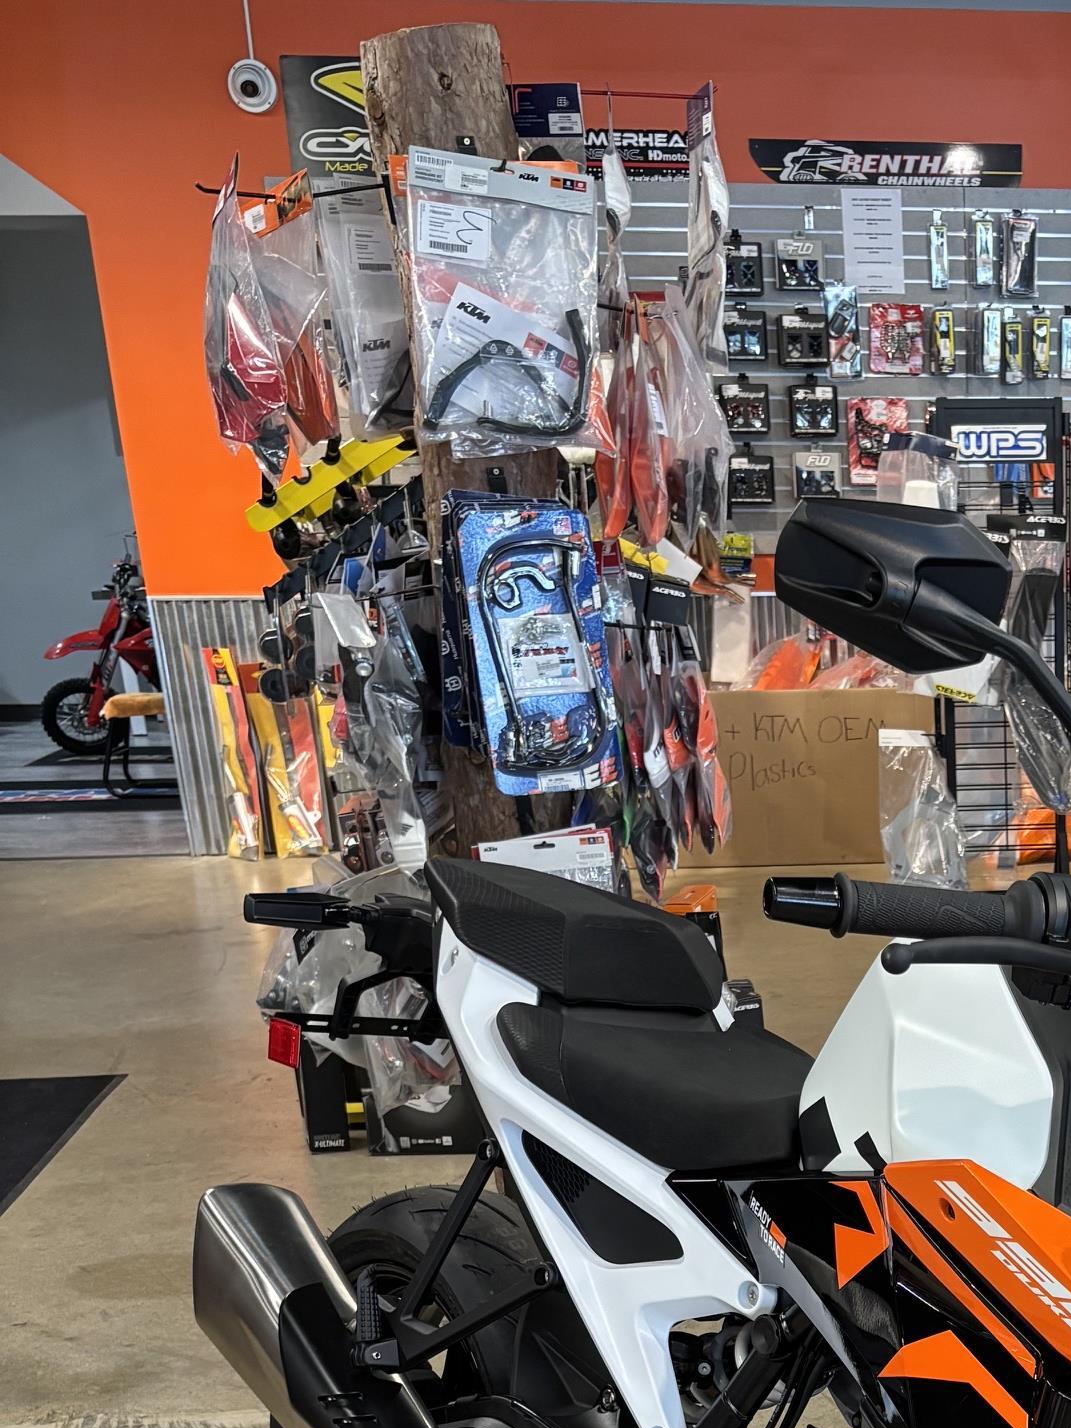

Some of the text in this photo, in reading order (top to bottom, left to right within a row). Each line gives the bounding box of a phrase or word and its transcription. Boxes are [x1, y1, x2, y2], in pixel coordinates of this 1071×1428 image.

[325, 161, 368, 172] Made
[840, 154, 982, 175] RENTHAL
[518, 172, 539, 183] KTM
[877, 175, 982, 188] CHAINWHEELS
[456, 301, 491, 325] KTM
[362, 338, 391, 352] KTM
[957, 430, 1045, 459] WPS
[806, 455, 831, 467] FLO
[753, 712, 808, 744] KTM
[727, 751, 817, 792] Plastics
[749, 1196, 772, 1229] READY
